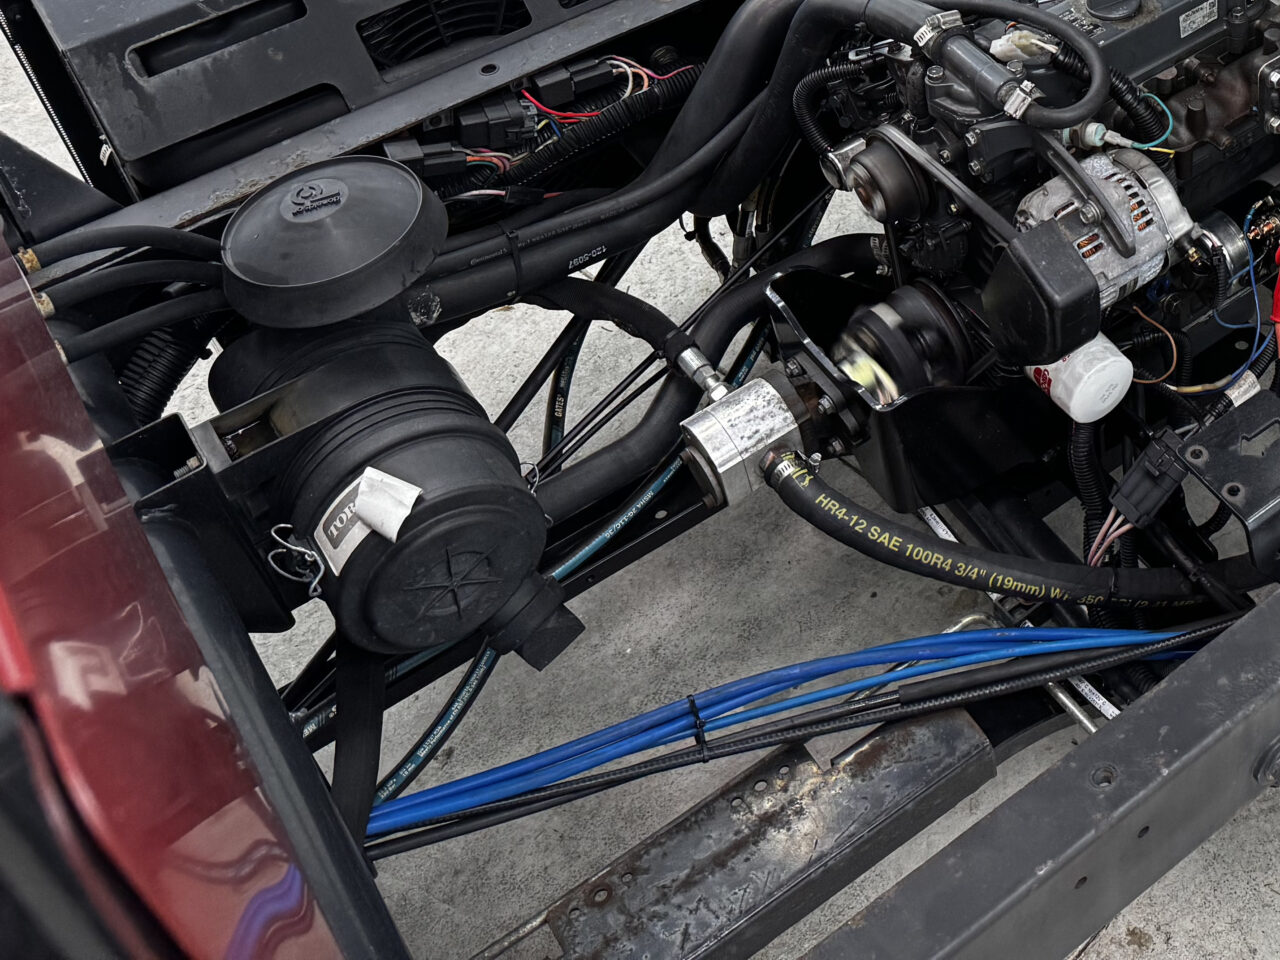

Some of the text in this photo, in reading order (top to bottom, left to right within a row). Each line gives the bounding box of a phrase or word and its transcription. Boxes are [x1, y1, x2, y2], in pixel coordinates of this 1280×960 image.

[327, 502, 357, 538] TOR
[815, 493, 867, 533] HR4-12
[868, 526, 903, 551] SAE
[905, 543, 953, 572] 100R4
[954, 562, 987, 580] 3/4"
[988, 572, 1046, 598] (19mm)
